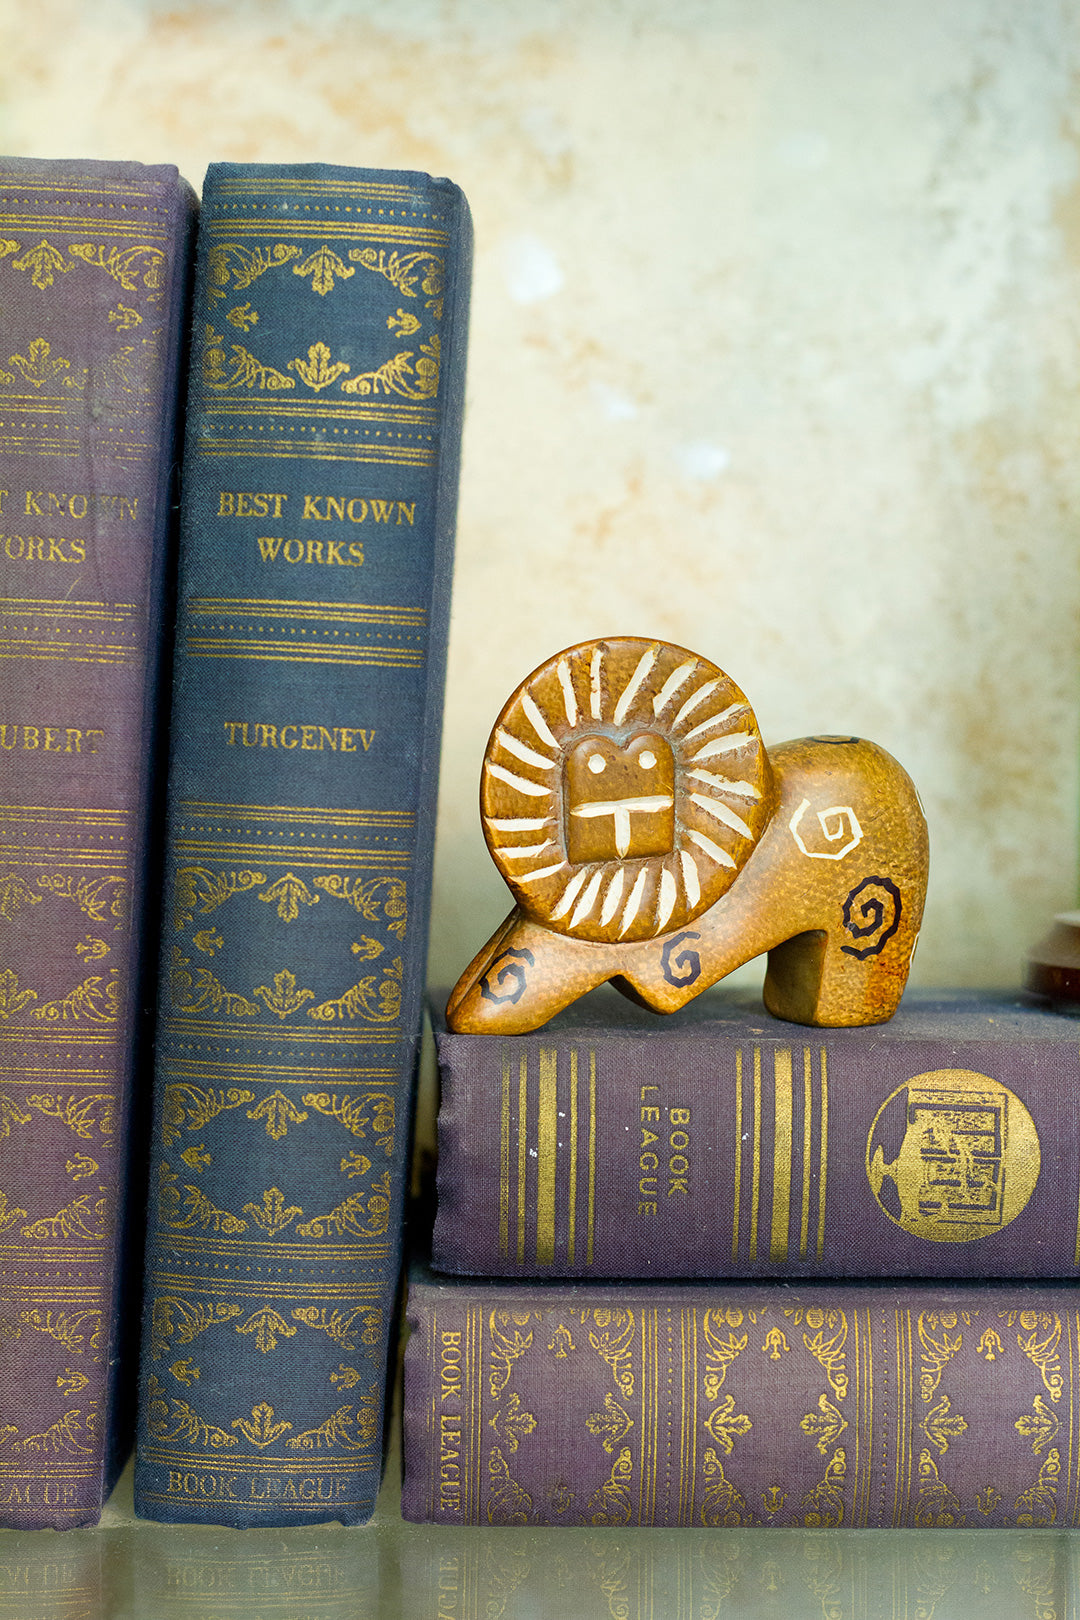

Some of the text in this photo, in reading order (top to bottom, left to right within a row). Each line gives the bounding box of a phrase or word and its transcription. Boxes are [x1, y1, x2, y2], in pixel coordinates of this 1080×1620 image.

[217, 491, 417, 526] BEST KNOWN
[0, 534, 86, 563] ORKS
[257, 536, 365, 568] WORKS
[223, 721, 376, 752] TURGENEV
[637, 1085, 661, 1216] LEAGUE
[667, 1107, 691, 1196] BOOK
[440, 1331, 462, 1511] BOOK LEAGUE
[167, 1471, 350, 1499] BOOK LEAGUE
